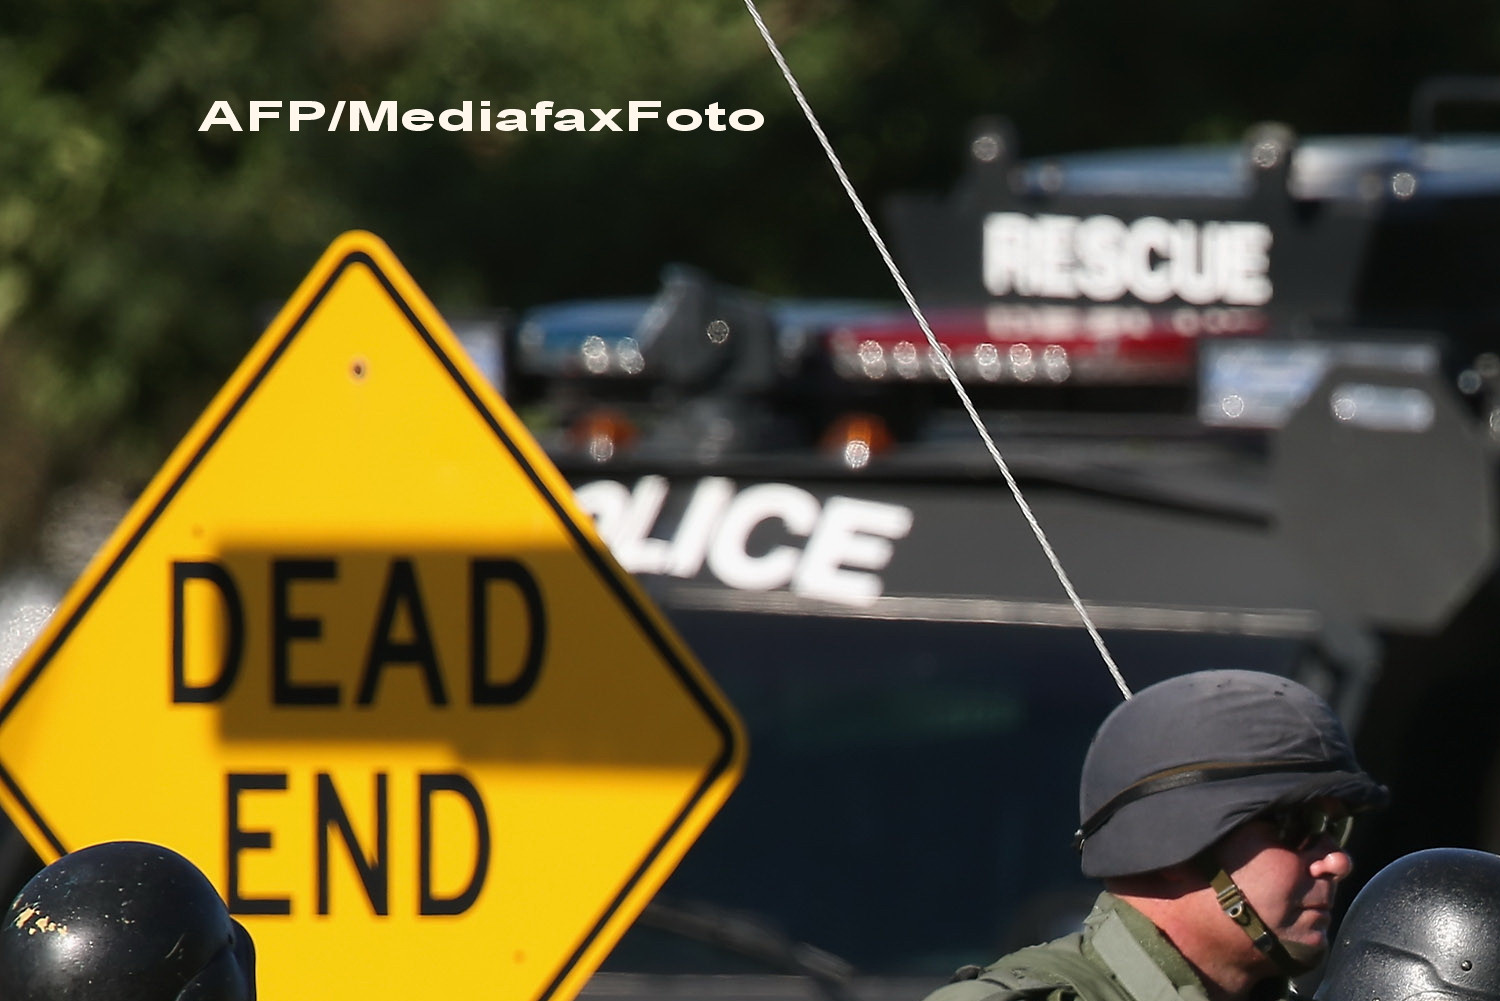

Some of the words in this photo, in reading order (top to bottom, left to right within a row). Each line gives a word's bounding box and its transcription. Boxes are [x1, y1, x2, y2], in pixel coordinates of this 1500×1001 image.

[982, 211, 1274, 306] RESCUE
[171, 559, 546, 705] DEAD
[227, 772, 491, 916] END
